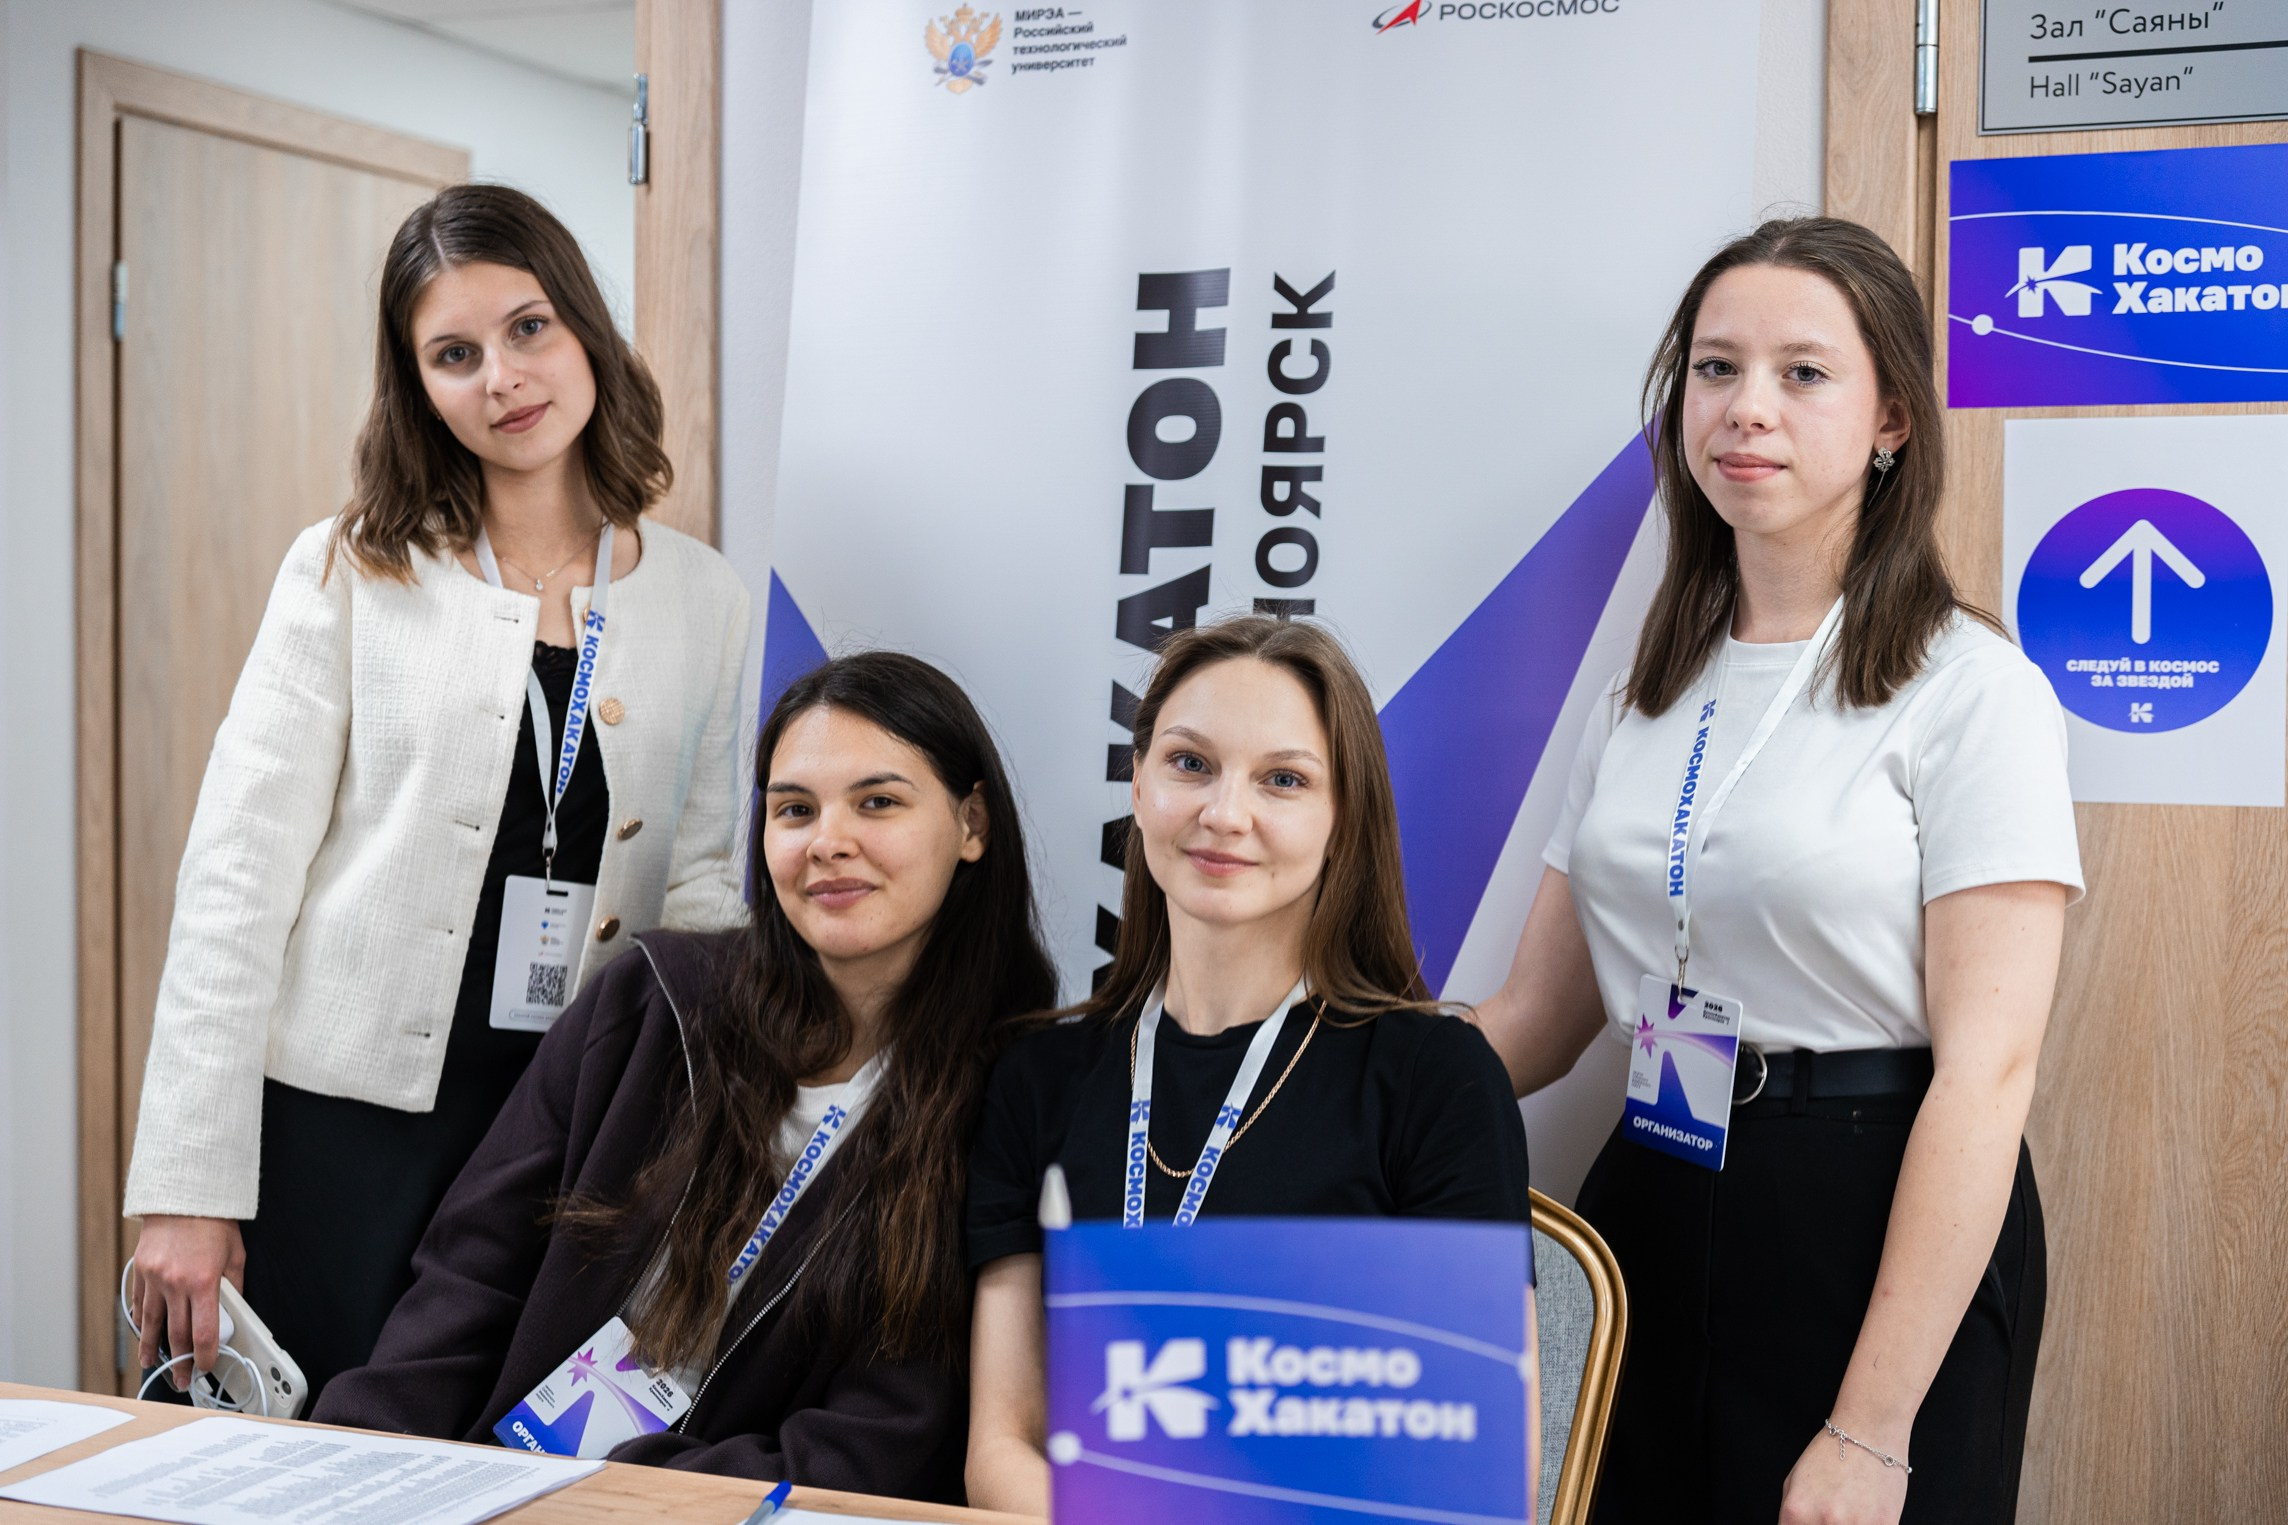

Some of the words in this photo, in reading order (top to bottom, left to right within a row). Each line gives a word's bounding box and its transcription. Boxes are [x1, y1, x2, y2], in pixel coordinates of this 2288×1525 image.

[1014, 8, 1064, 22] МИРЭА
[1439, 0, 1620, 20] РОСКОСМОС
[1013, 22, 1094, 38] Российский
[2030, 13, 2084, 39] Зал
[1012, 35, 1127, 55] технологический
[1011, 56, 1095, 75] университет
[2030, 73, 2080, 99] Hall
[2112, 242, 2264, 276] Космо
[2112, 280, 2288, 315] Хакато
[2066, 657, 2131, 673] СЛЕДУЙ
[2134, 660, 2146, 673] В
[2149, 660, 2220, 674] КОСМОС
[2091, 675, 2113, 688] ЗА
[2117, 673, 2194, 689] ЗВЕЗДОЙ
[556, 634, 600, 795] КОСМОХАКАТОН
[1669, 725, 1709, 897] КОСМОХАКАТОН
[1632, 1115, 1714, 1151] ОРГАНИЗАТОР
[1226, 1336, 1422, 1388] Космо
[655, 1378, 674, 1398] 2026
[1227, 1388, 1477, 1443] Хакатон
[512, 1420, 549, 1454] ОРГАН
